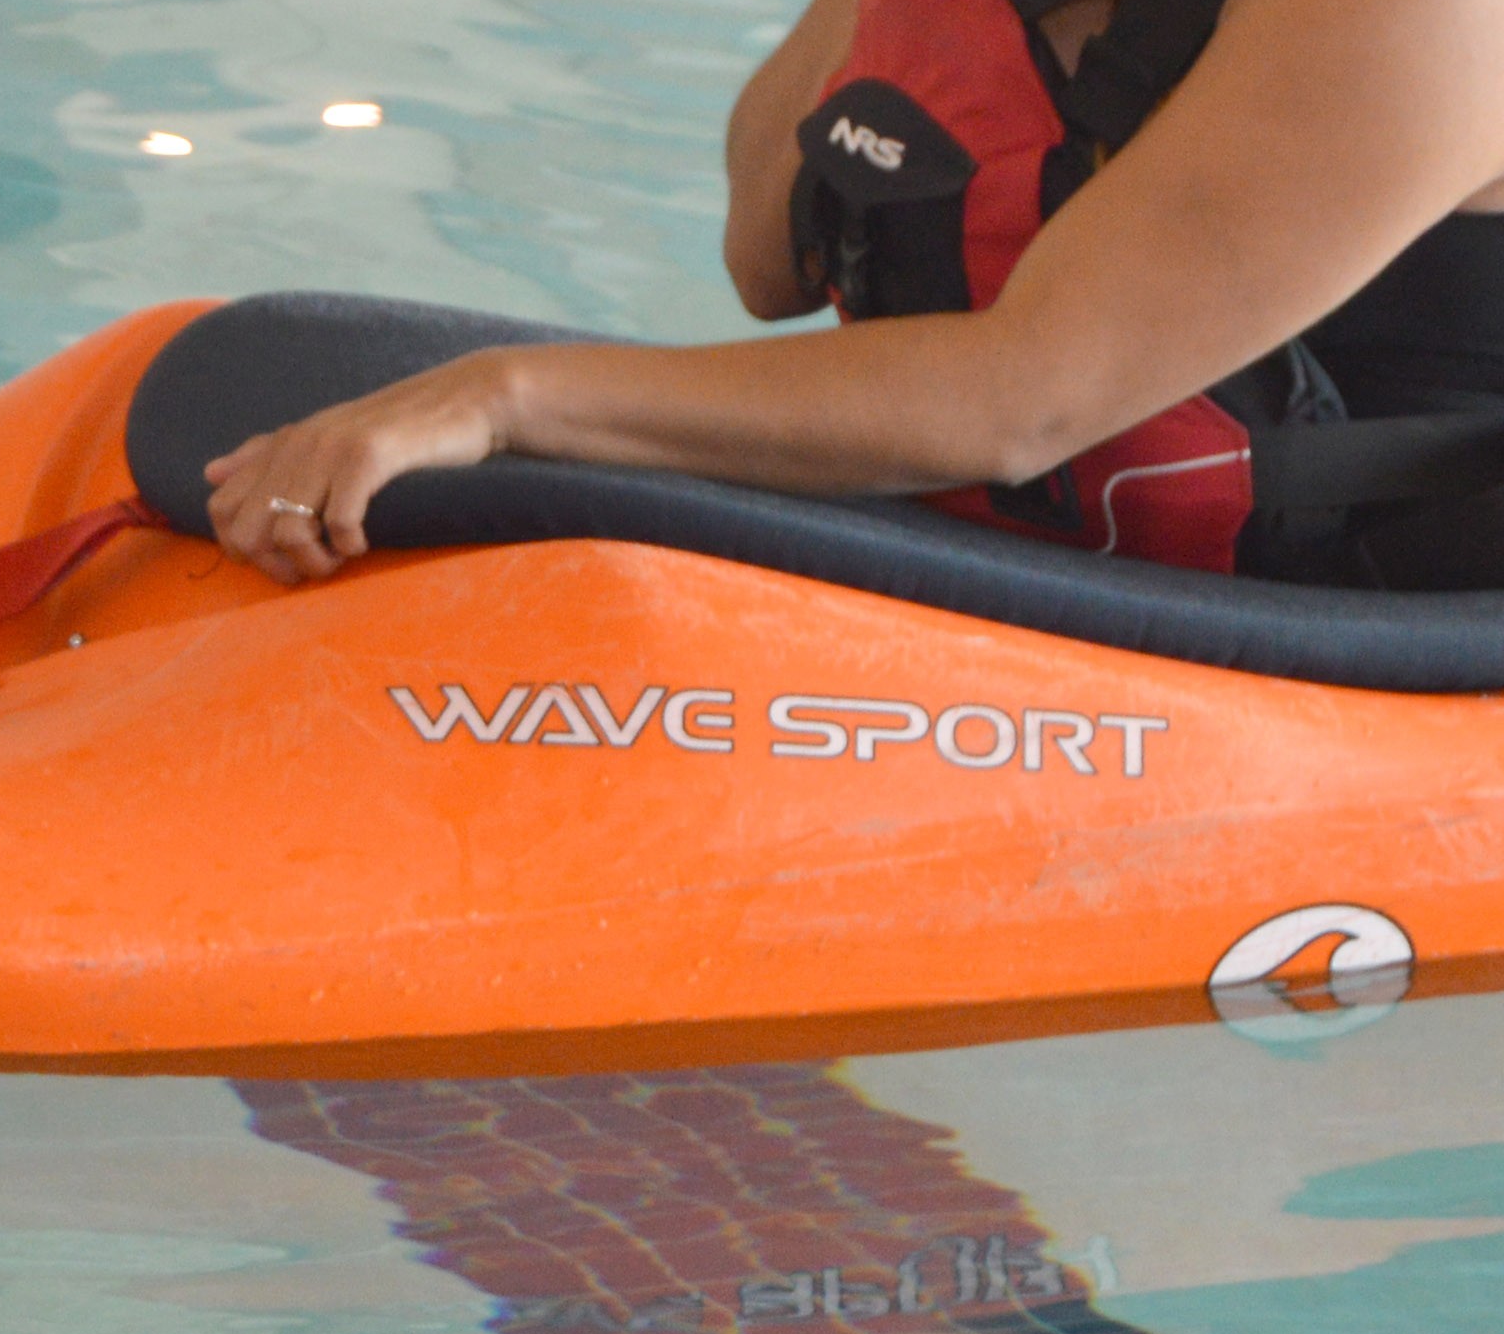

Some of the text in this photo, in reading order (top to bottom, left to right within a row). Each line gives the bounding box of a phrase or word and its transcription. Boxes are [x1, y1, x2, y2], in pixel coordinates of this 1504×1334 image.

[828, 115, 906, 171] NRS
[387, 682, 1169, 779] WAVE SPORT
